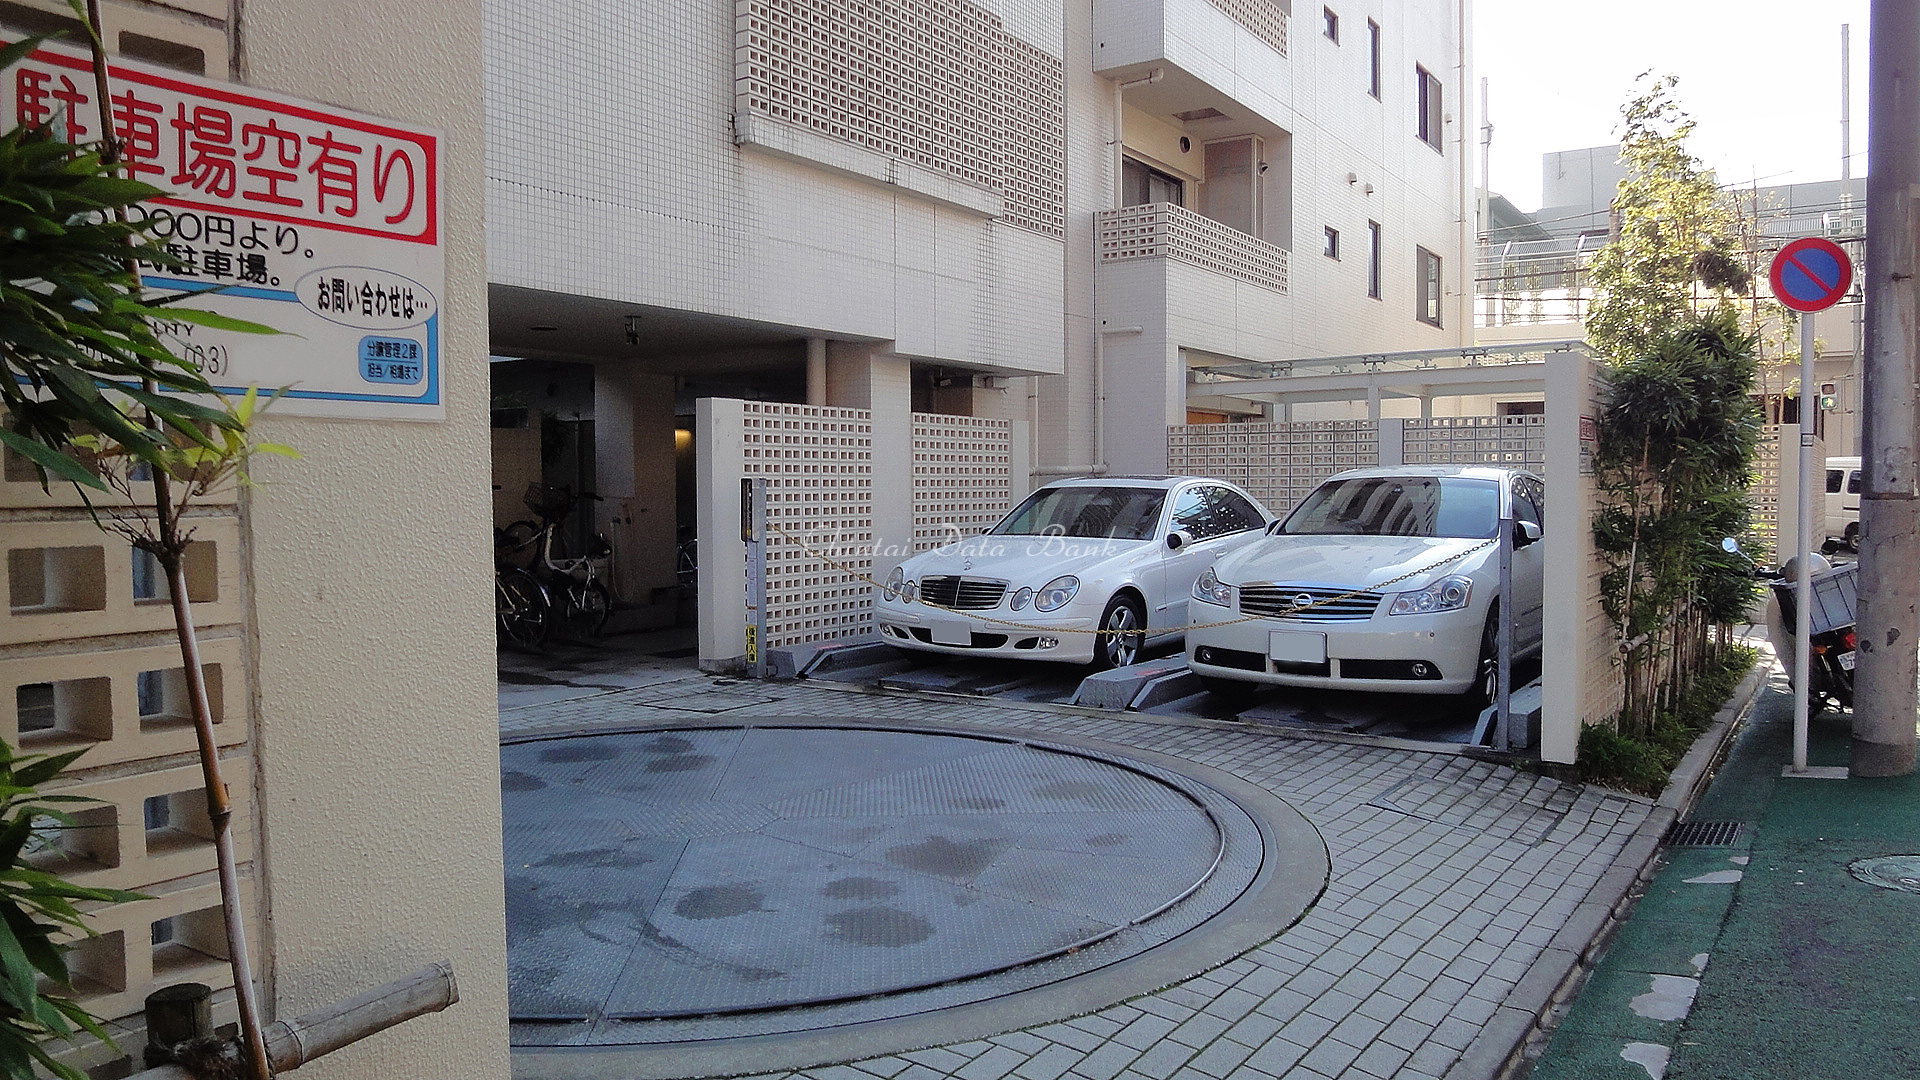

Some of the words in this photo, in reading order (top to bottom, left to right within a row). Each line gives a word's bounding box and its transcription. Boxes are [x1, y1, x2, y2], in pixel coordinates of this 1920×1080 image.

[16, 68, 414, 224] 駐車場空有り
